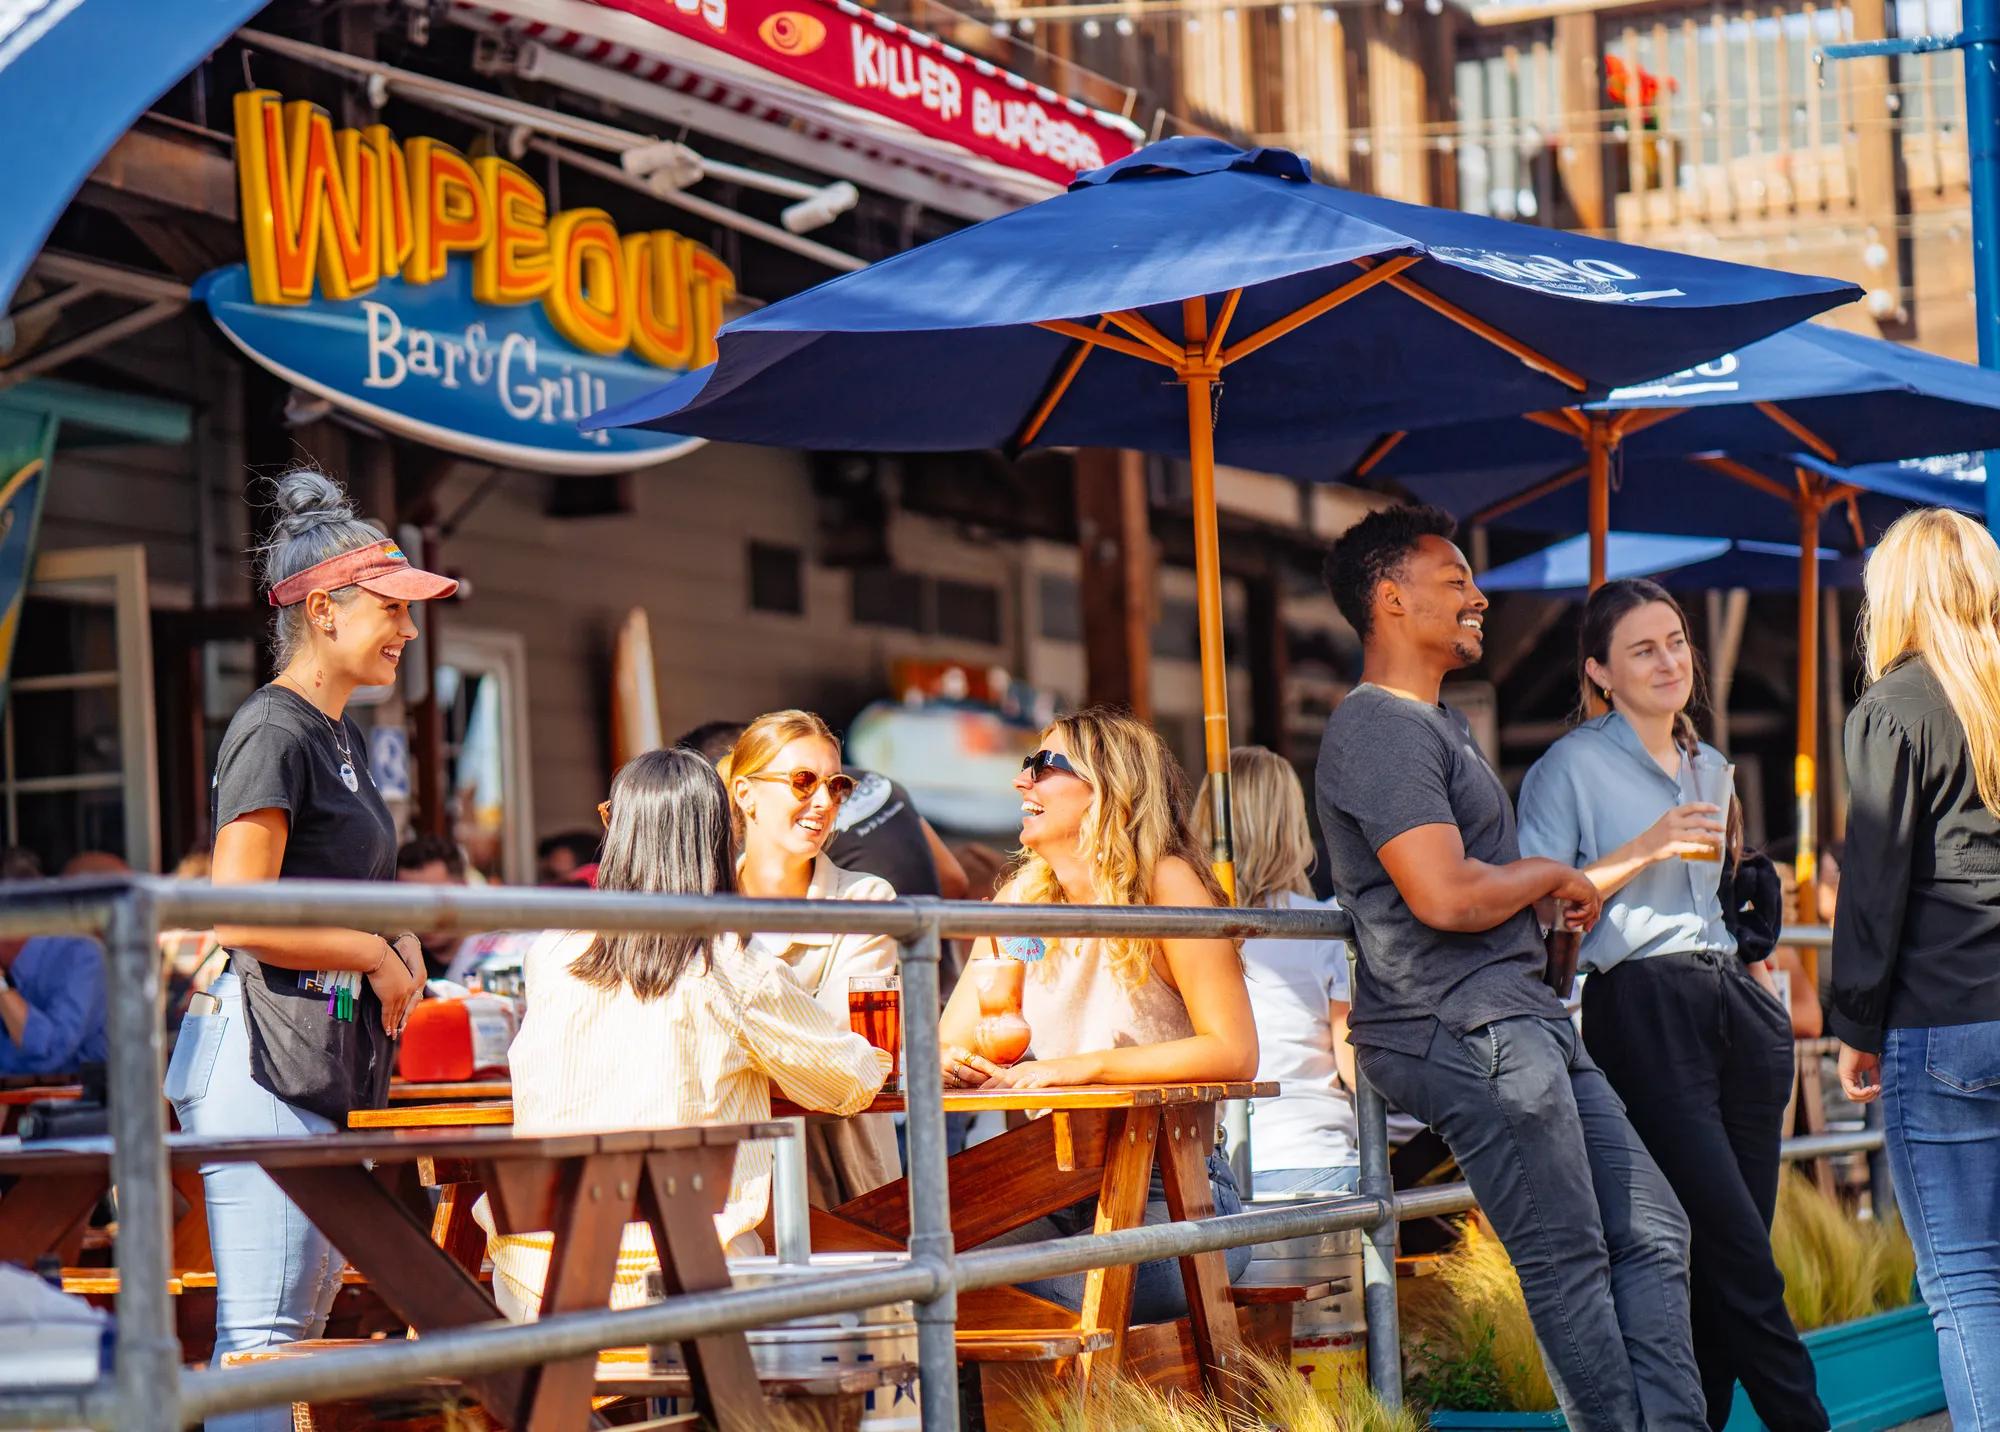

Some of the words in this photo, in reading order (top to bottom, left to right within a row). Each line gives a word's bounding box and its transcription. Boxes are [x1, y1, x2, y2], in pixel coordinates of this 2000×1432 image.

[850, 23, 962, 121] KILLER
[972, 87, 1106, 172] BURGERS
[234, 89, 735, 370] WIPEOUT
[360, 301, 465, 389] Bar
[498, 332, 610, 446] Grill
